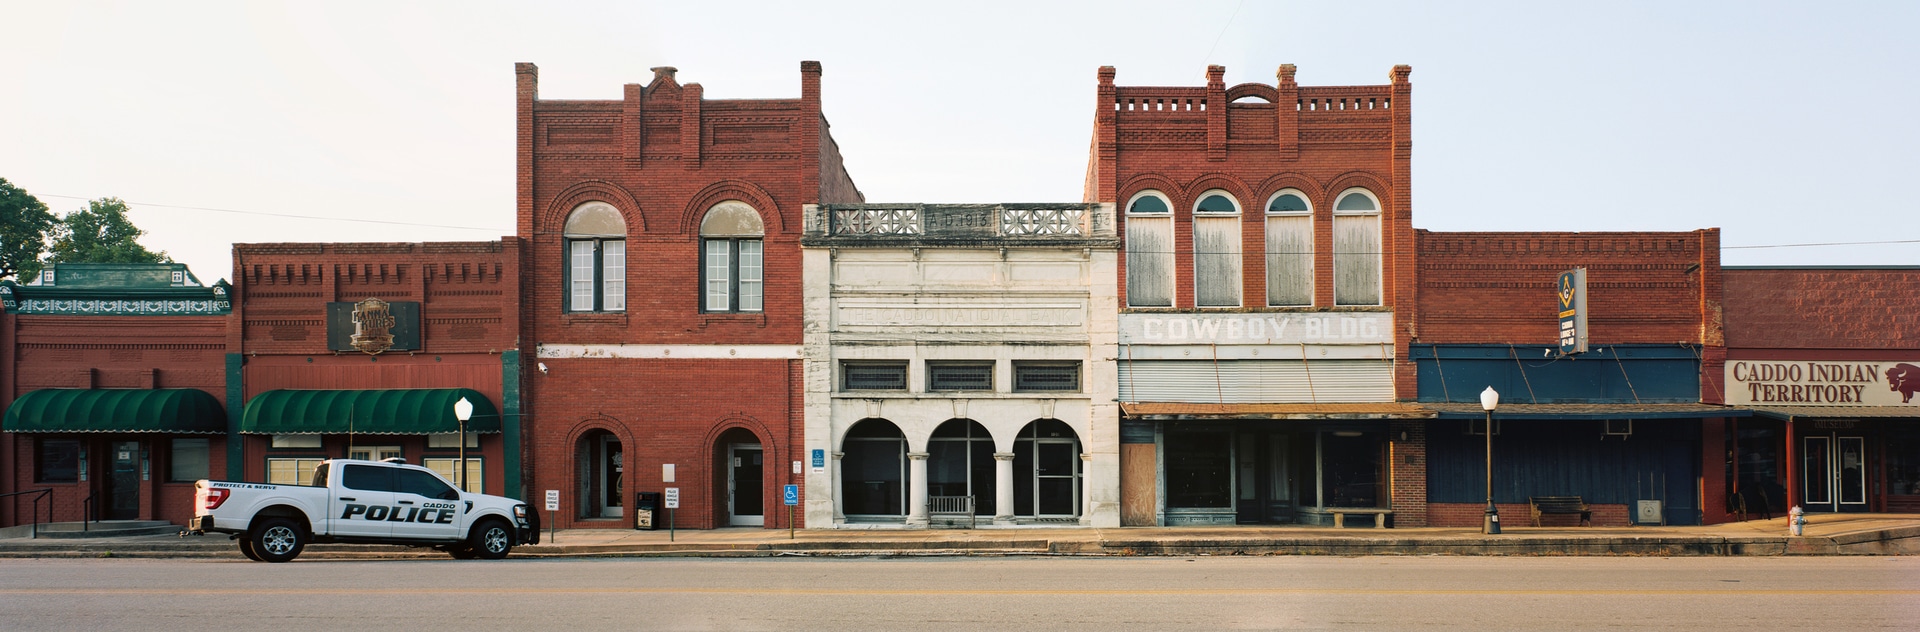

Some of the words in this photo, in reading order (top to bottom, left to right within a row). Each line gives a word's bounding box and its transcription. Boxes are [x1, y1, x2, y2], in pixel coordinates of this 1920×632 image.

[353, 310, 389, 323] KANNA
[361, 318, 395, 331] KURES
[847, 309, 874, 321] THE
[881, 309, 935, 321] CADDO
[945, 309, 1021, 321] NATIONAL
[1030, 309, 1072, 321] BANK
[1143, 317, 1291, 340] COWBOY
[1305, 316, 1383, 340] BLDG.
[1733, 361, 1802, 382] CADDO
[1807, 362, 1880, 383] INDIAN
[1748, 382, 1865, 403] TERRITORY
[340, 503, 456, 524] POLICE
